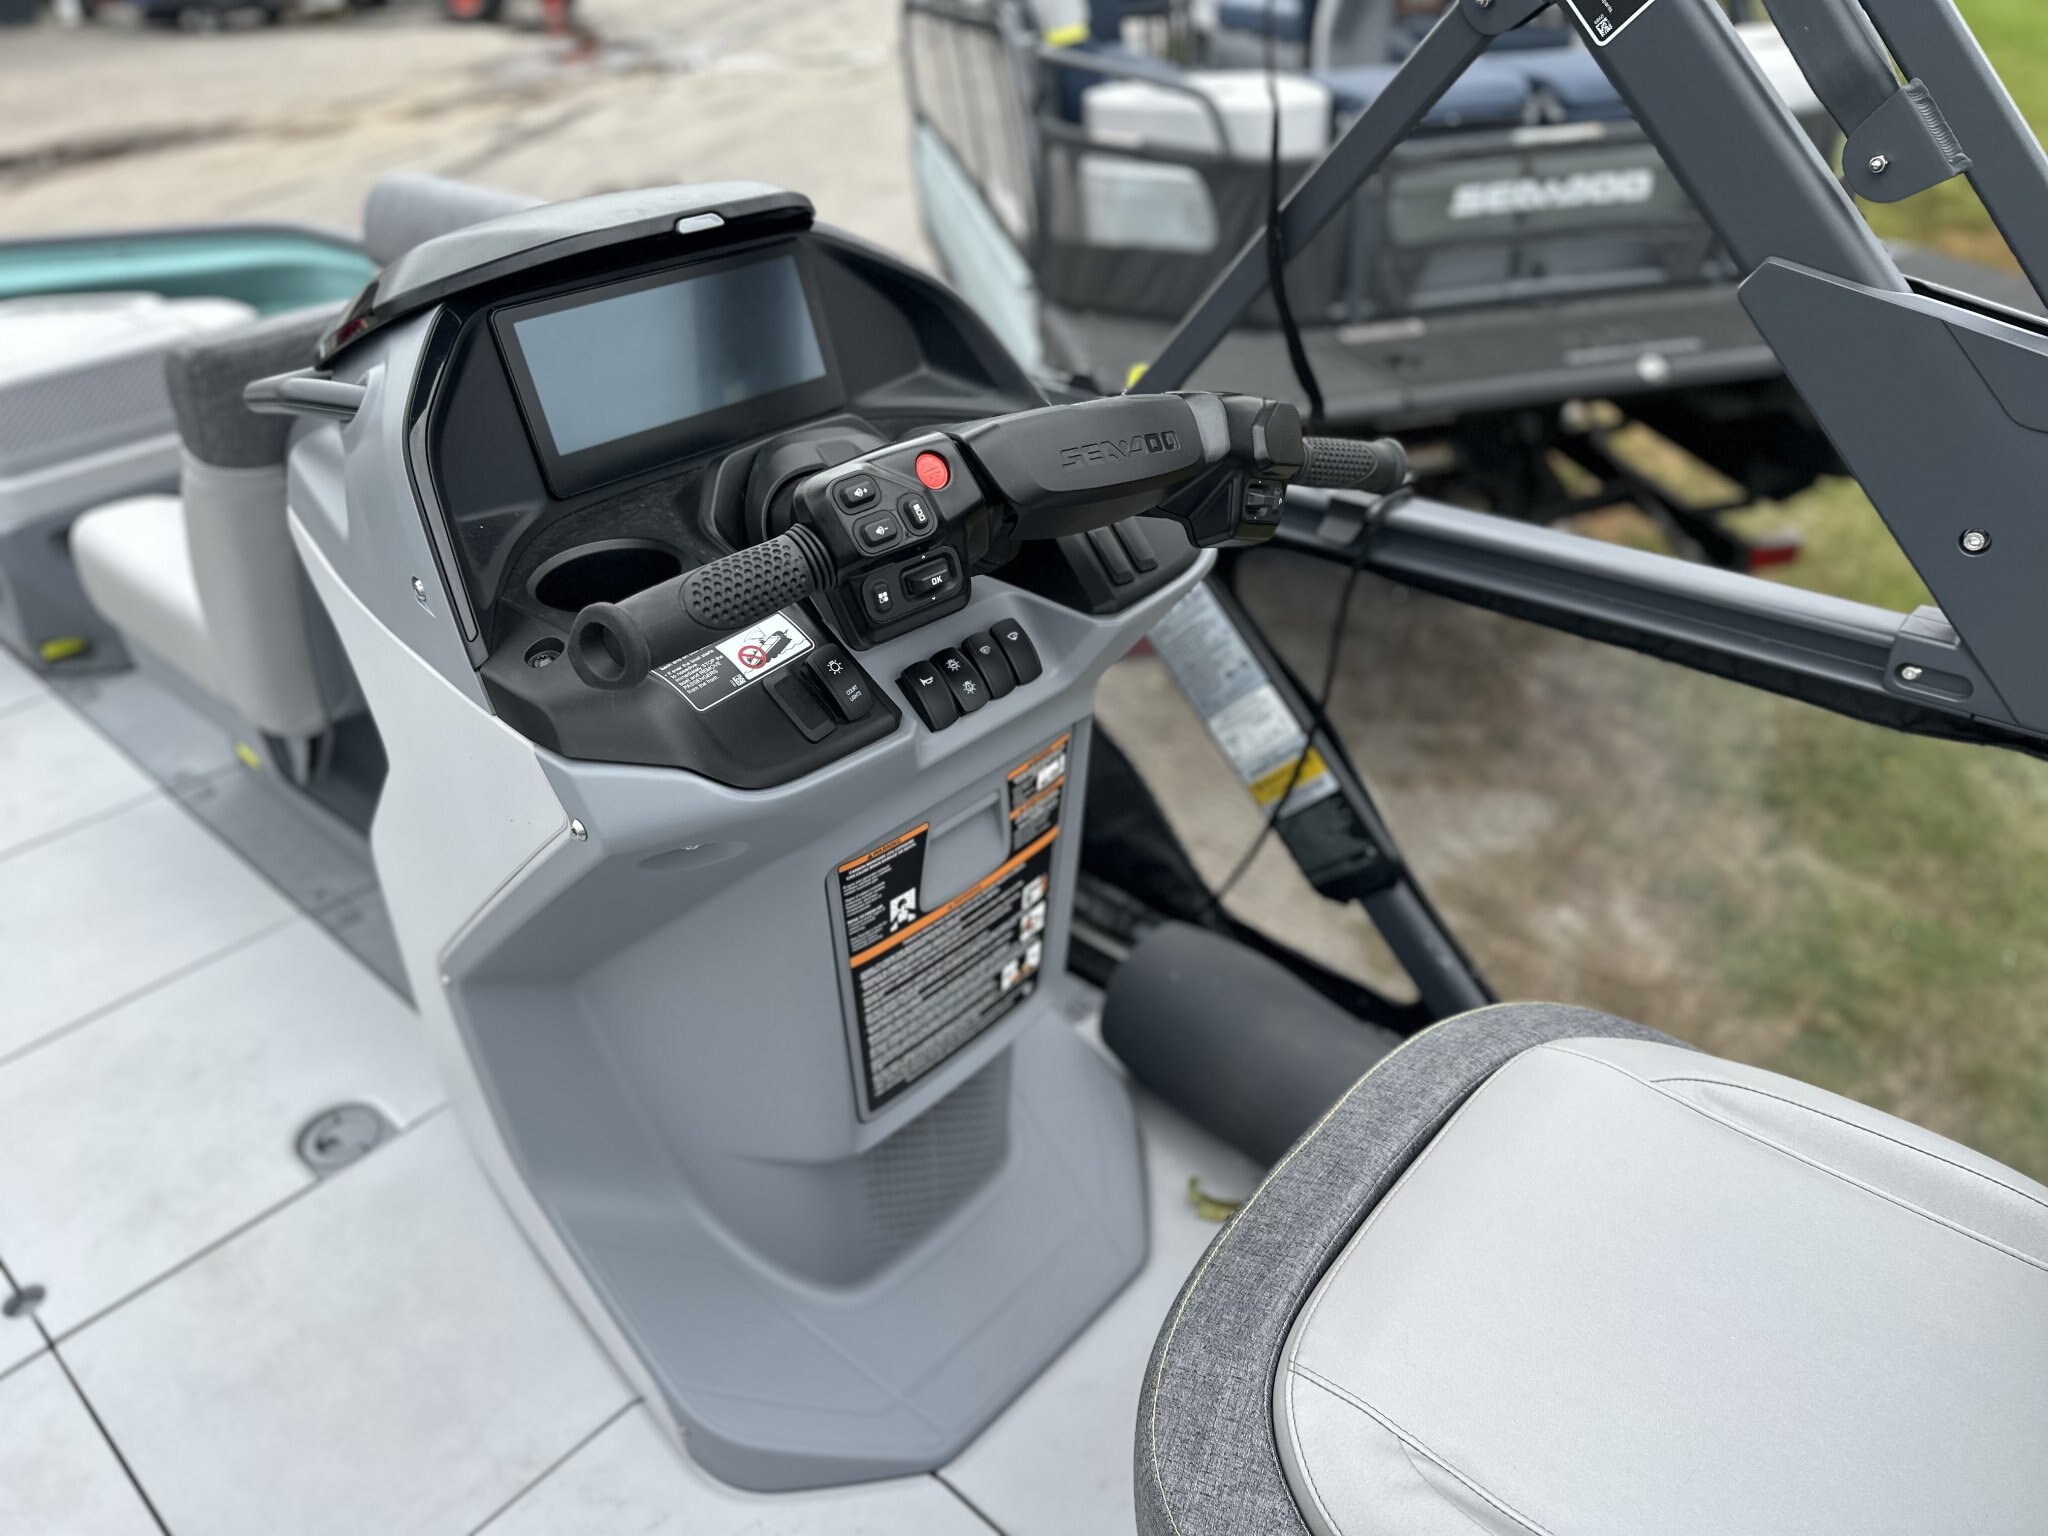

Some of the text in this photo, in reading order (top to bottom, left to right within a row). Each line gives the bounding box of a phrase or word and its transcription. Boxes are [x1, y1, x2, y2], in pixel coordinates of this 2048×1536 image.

[931, 575, 943, 586] OK
[690, 655, 701, 664] boat
[700, 649, 715, 658] starts
[701, 658, 715, 668] STOP
[678, 660, 722, 687] boat and REMOVE
[682, 668, 719, 691] PASSENGERS
[686, 686, 699, 694] from
[698, 681, 707, 689] the
[845, 684, 858, 696] COURT
[849, 690, 862, 702] LIGHTS
[872, 838, 902, 857] WARNING
